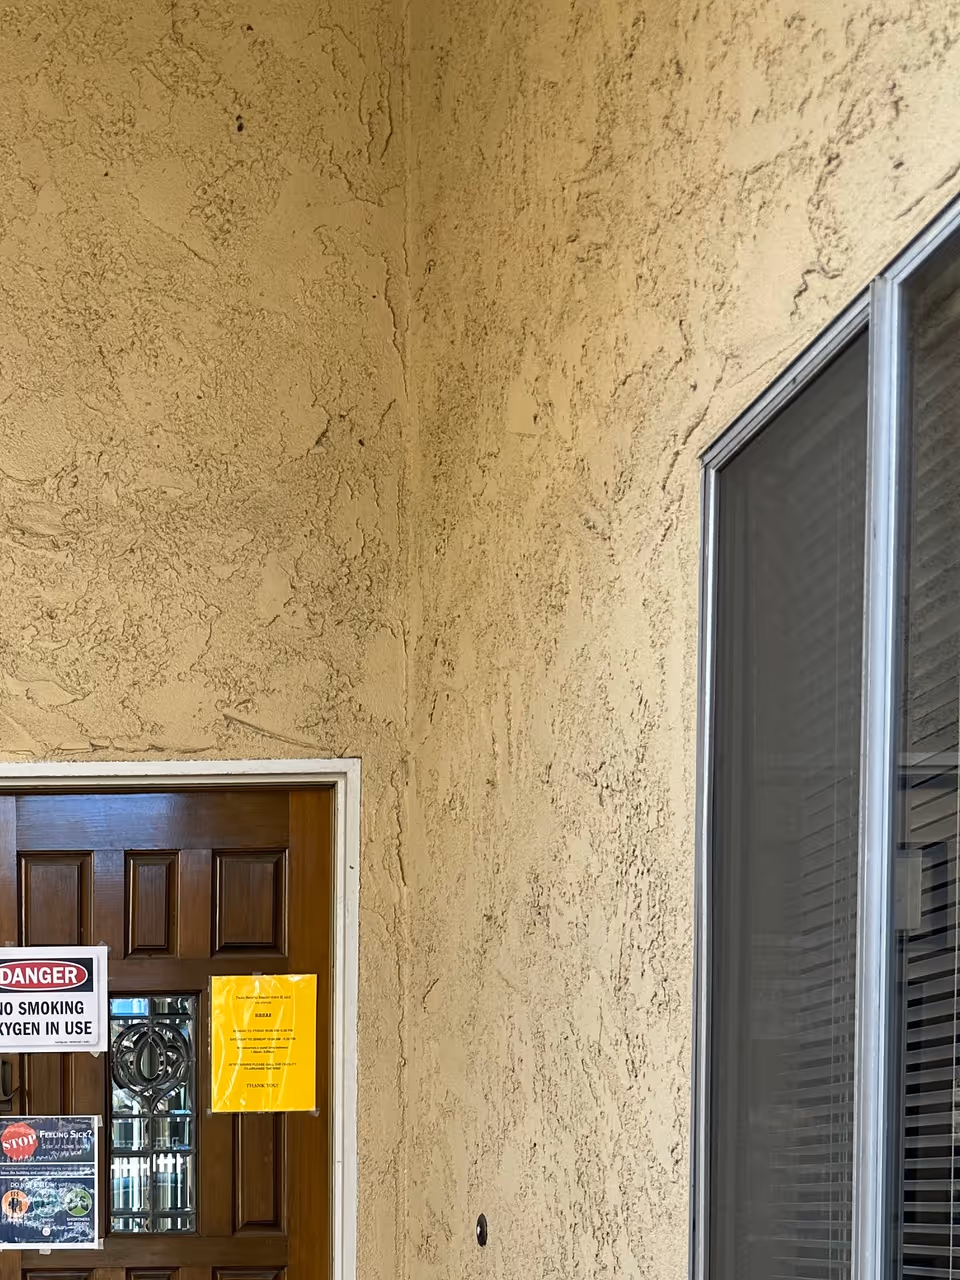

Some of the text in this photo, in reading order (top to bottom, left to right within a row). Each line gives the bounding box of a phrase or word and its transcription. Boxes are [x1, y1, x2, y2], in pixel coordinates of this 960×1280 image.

[0, 966, 78, 985] DANGER
[18, 1000, 84, 1015] SMOKING
[45, 1021, 60, 1035] IN
[65, 1021, 92, 1035] USE
[70, 1129, 92, 1138] SICK?
[2, 1134, 37, 1151] STOP
